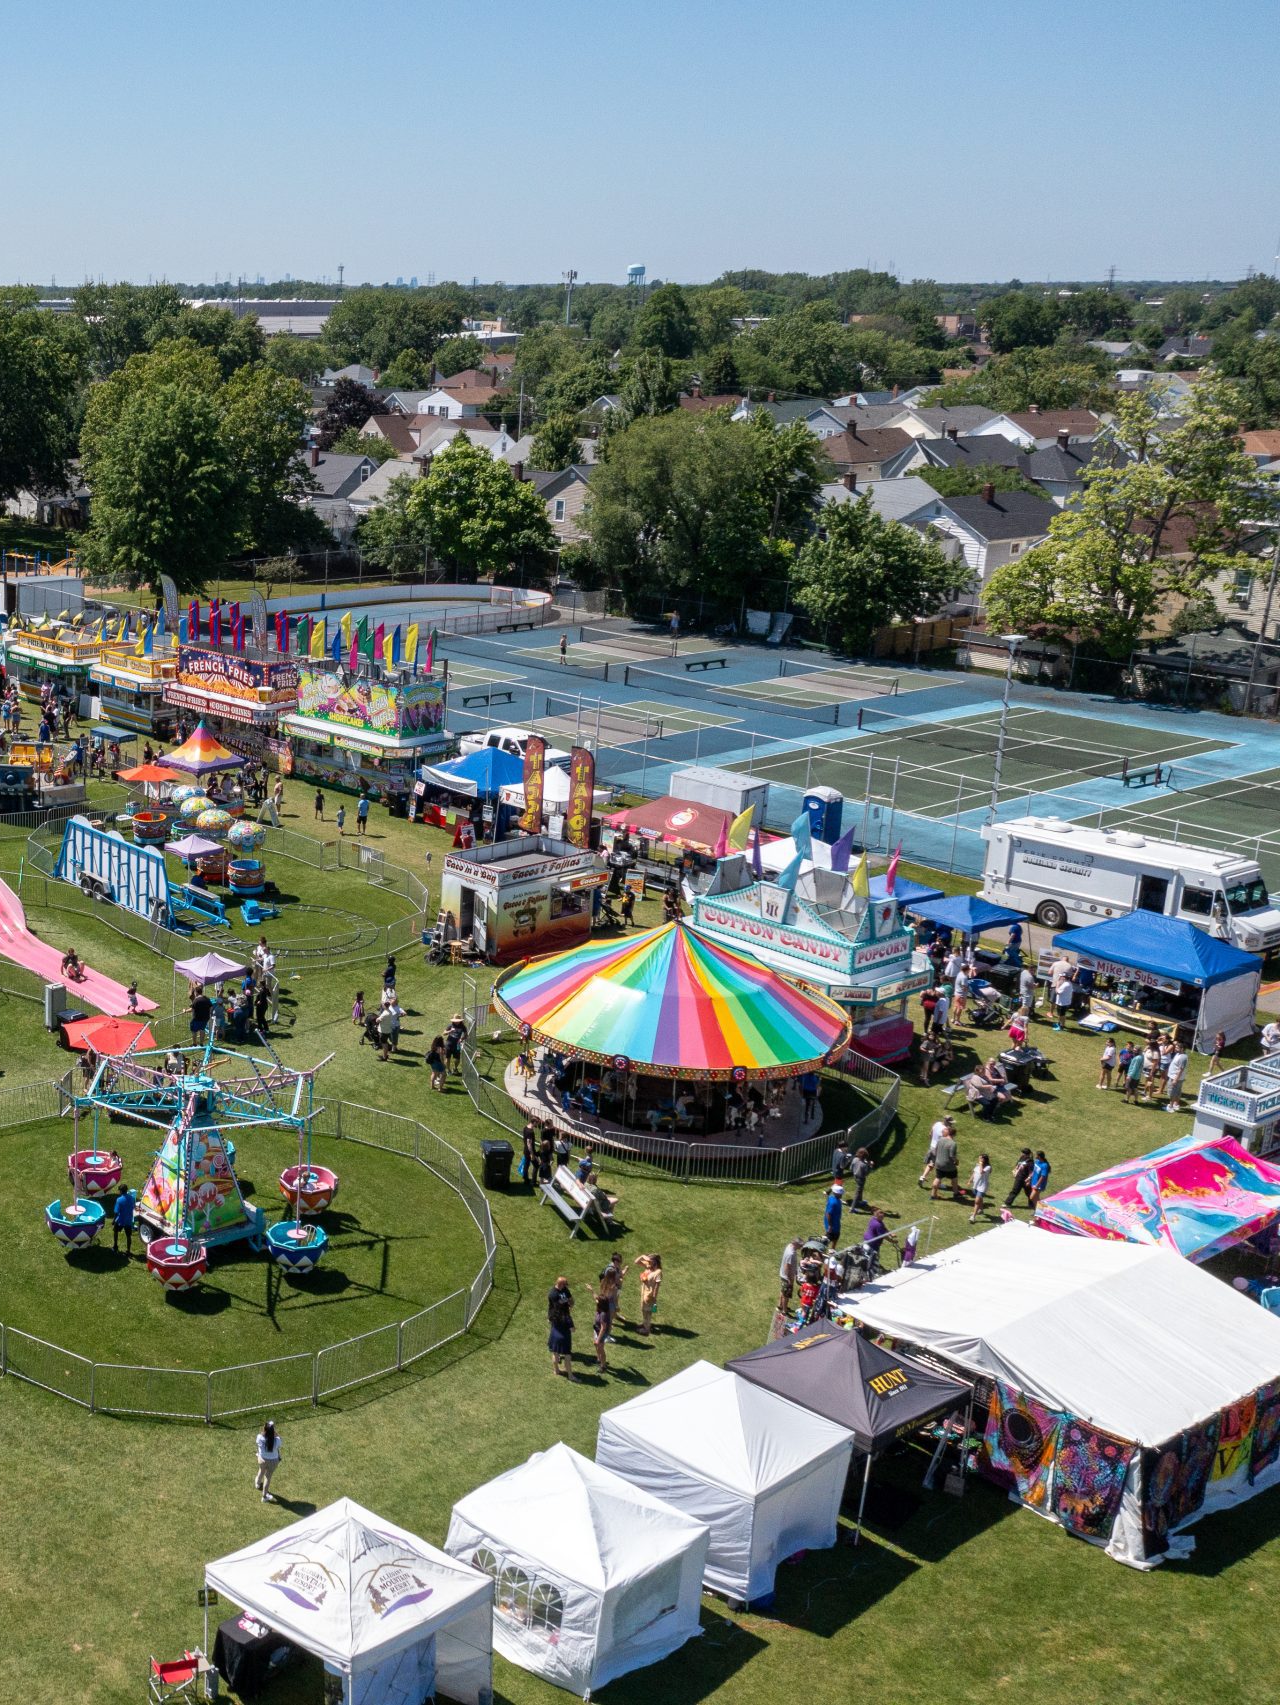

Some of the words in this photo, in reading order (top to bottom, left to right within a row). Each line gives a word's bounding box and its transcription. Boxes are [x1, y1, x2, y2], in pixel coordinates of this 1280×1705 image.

[188, 660, 225, 673] FRENCH
[228, 665, 255, 687] FRIES
[277, 680, 298, 688] FRIES
[209, 701, 231, 713] COLD
[1024, 849, 1046, 858] ERIE
[1052, 855, 1092, 867] COUNTY
[446, 859, 464, 872] Taco
[480, 870, 496, 885] Bag
[511, 867, 539, 881] Tacos
[549, 857, 581, 874] Fajitas
[579, 876, 601, 886] Tacos
[701, 903, 775, 941] COTTON
[778, 929, 843, 963] CANDY
[856, 940, 908, 964] POPCORN
[1096, 961, 1131, 979] Mike's
[1133, 970, 1159, 987] Subs
[1207, 1092, 1246, 1112] TICKETS
[869, 1368, 909, 1394] HUNT
[888, 1388, 900, 1397] Since
[379, 1572, 411, 1591] MOUNTAIN
[389, 1580, 411, 1594] RESORT
